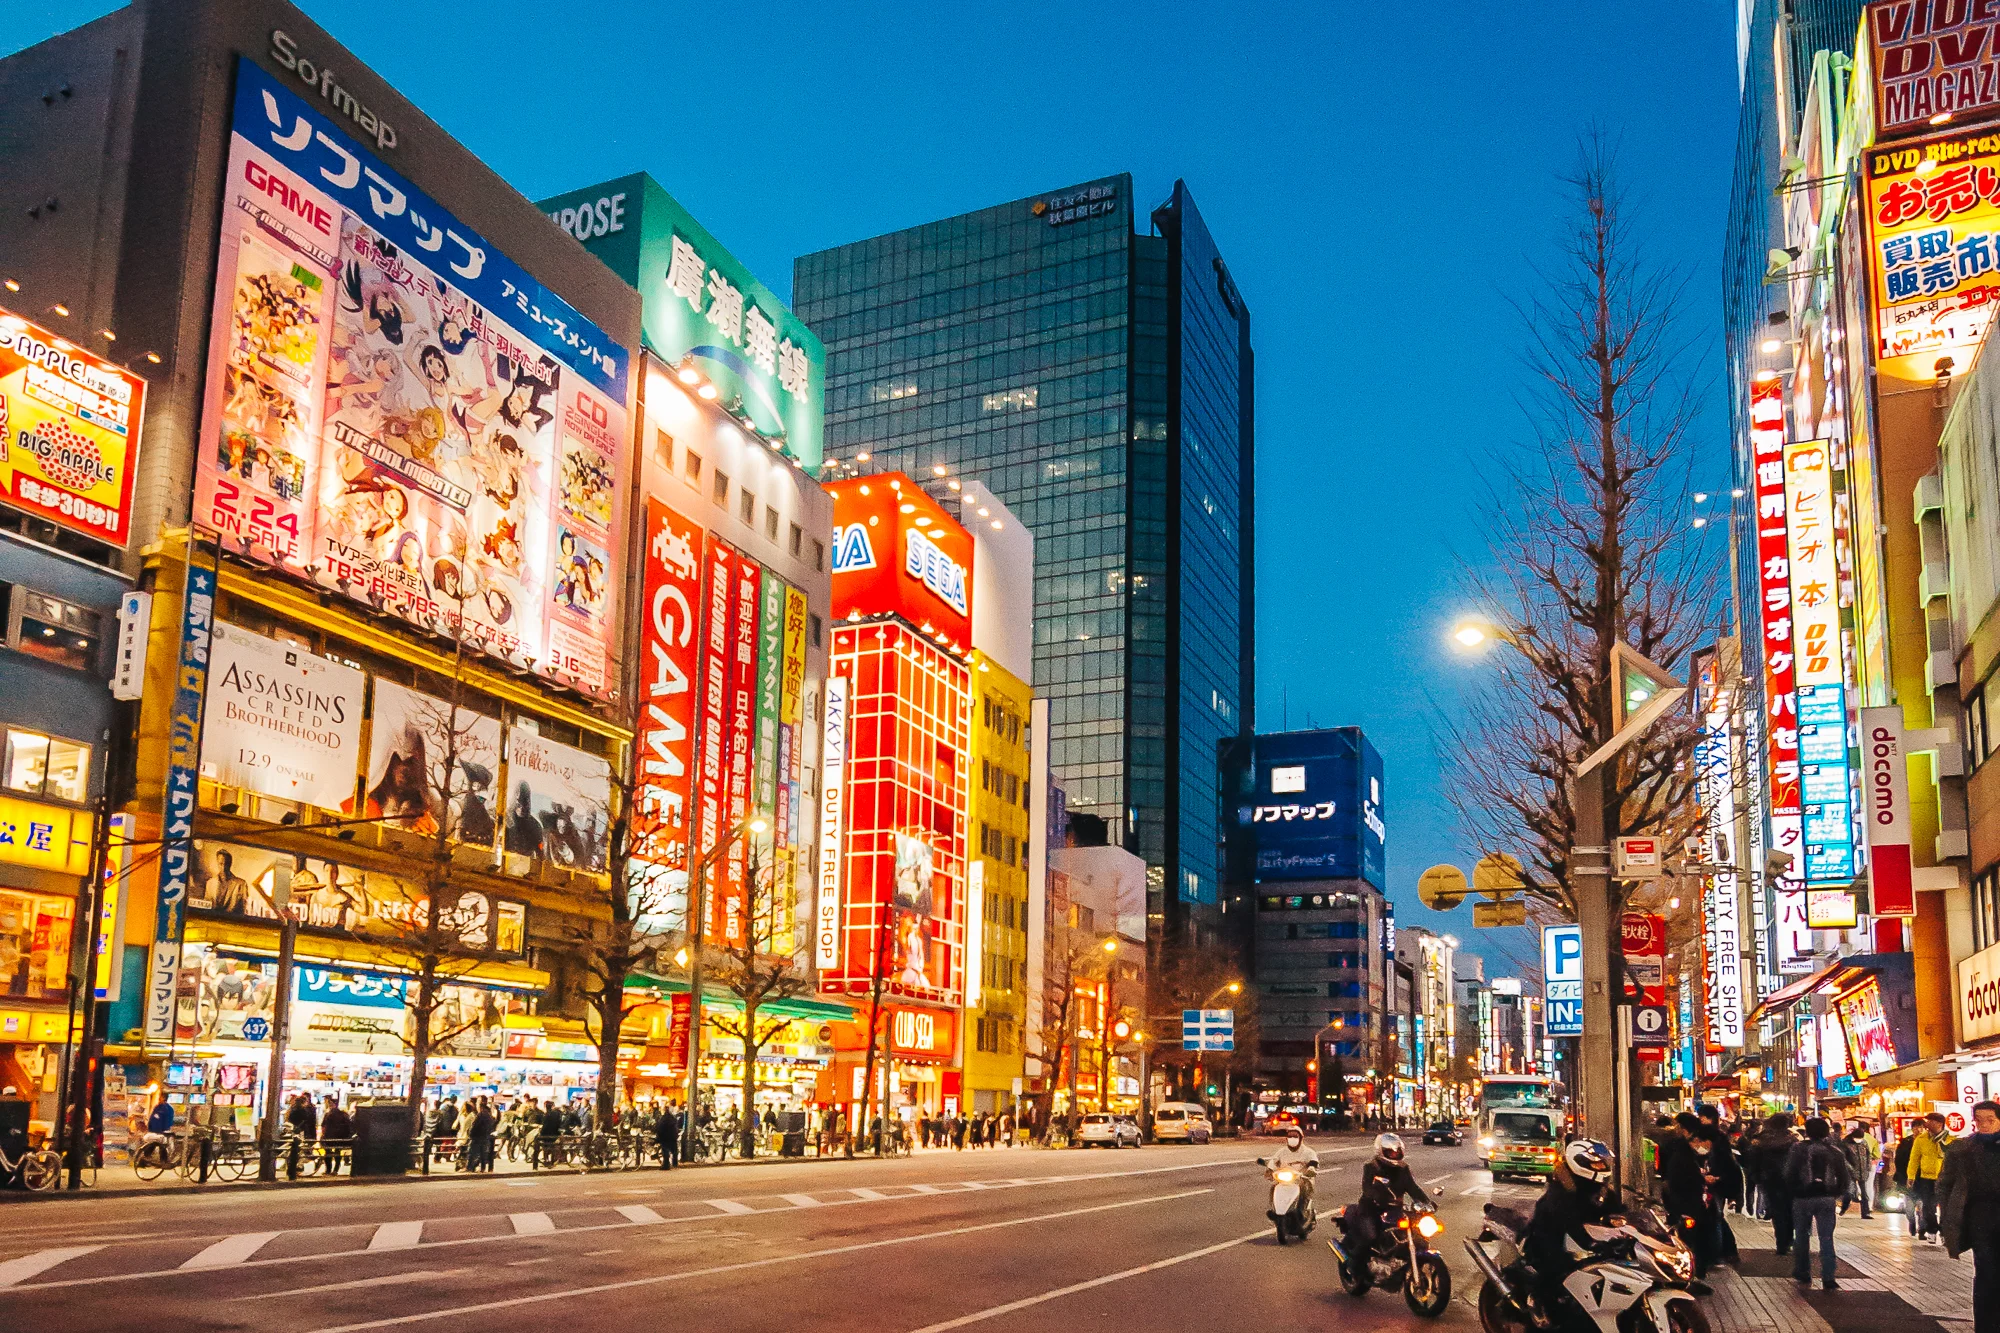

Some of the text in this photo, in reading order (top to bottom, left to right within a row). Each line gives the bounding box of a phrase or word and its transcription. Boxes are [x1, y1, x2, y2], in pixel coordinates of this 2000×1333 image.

[1881, 26, 2000, 80] DV
[271, 29, 397, 150] Sofmap
[1885, 63, 2000, 125] MAGAZ
[262, 88, 486, 280] ソフマップ
[1875, 150, 1920, 174] DVD
[245, 160, 332, 236] GAME
[547, 193, 626, 241] ROSE
[1049, 201, 1115, 225] 秋葉原ビル
[1050, 185, 1114, 210] 住友不動産
[1883, 230, 1951, 268] 買取
[1956, 229, 2000, 278] 市
[1887, 262, 1955, 301] 販売
[665, 234, 808, 404] 廣瀬無線
[1896, 300, 1939, 324] 石丸本店
[576, 390, 607, 429] CD
[18, 430, 114, 484] BIG APPLE
[335, 421, 370, 460] THE
[212, 508, 299, 561] ON SALE
[214, 479, 299, 540] 2.24
[907, 531, 967, 613] SEGA
[1798, 580, 1828, 608] 本
[552, 650, 579, 673] 3.16
[1804, 623, 1830, 673] DVD
[643, 584, 693, 828] GAME
[706, 655, 724, 718] LATEST
[226, 700, 341, 749] BROTHERHOOD
[248, 696, 323, 728] CREED
[827, 690, 841, 752] AKKY
[238, 748, 316, 782] 12.9 ON SALE
[704, 718, 721, 780] GAMES
[1872, 727, 1894, 825] docomo
[701, 799, 719, 855] PRIZES
[824, 788, 838, 841] DUTY
[823, 848, 837, 899] FREE
[1718, 872, 1733, 920] DUTY
[821, 906, 836, 960] SHOP
[1555, 934, 1580, 974] P
[1720, 929, 1735, 976] FREE
[152, 953, 175, 1033] ソフマップ
[1722, 985, 1738, 1035] SHOP
[1967, 975, 2000, 1021] doco
[243, 1022, 265, 1035] 437
[894, 1011, 934, 1050] CLUB SEGA
